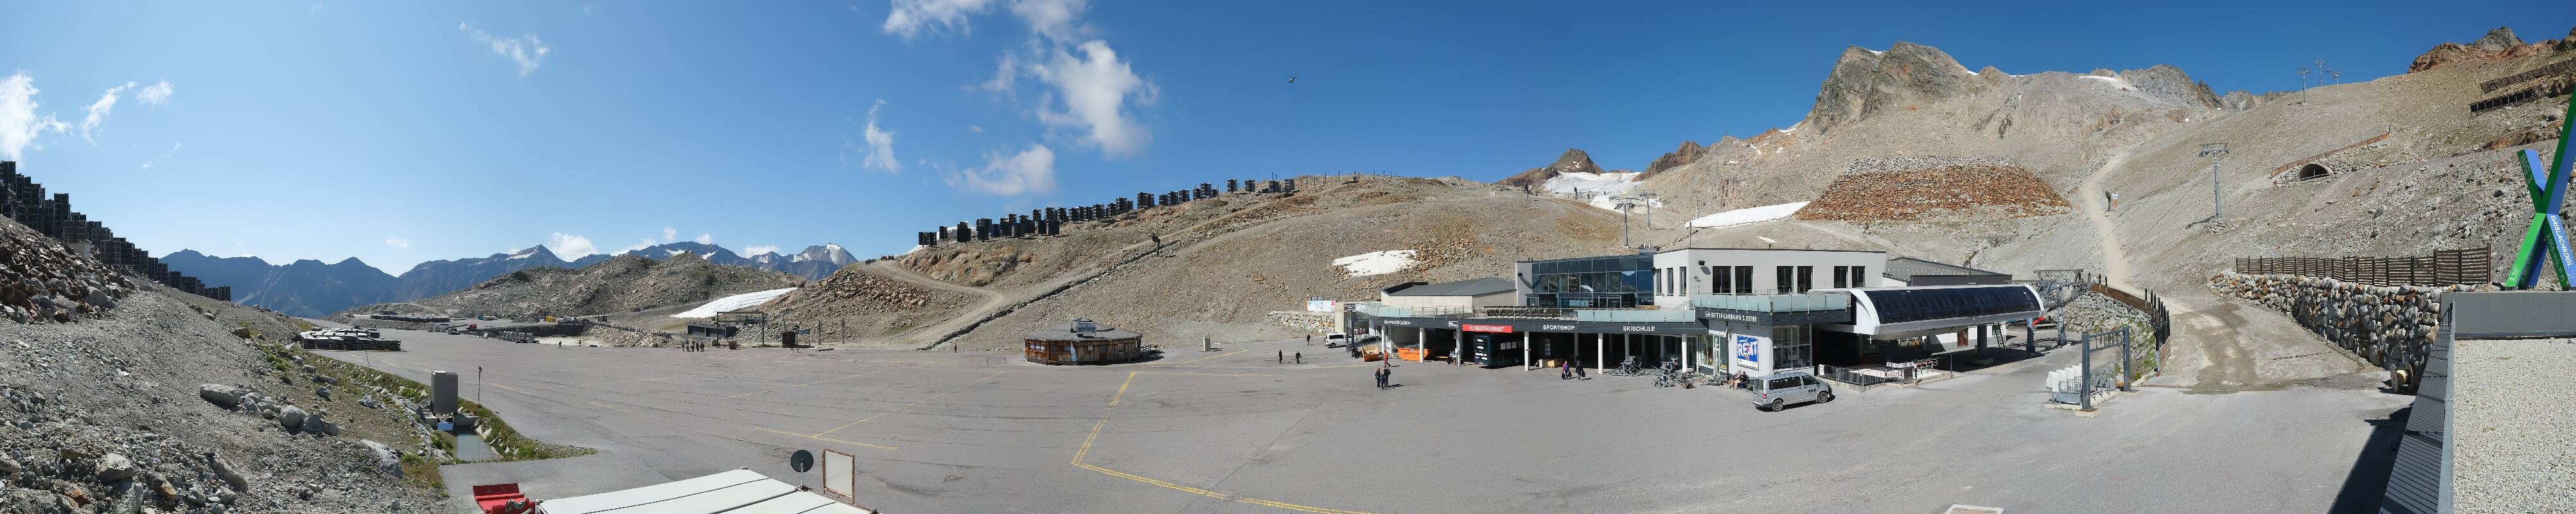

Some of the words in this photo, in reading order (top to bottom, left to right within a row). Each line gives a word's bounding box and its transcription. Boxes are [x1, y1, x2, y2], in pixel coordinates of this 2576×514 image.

[2520, 154, 2529, 175] BIG
[2527, 175, 2532, 183] 3
[2550, 215, 2573, 267] GAISLACHKOGL
[1711, 312, 1742, 321] SETERKARBAHN
[1738, 342, 1758, 357] RENT
